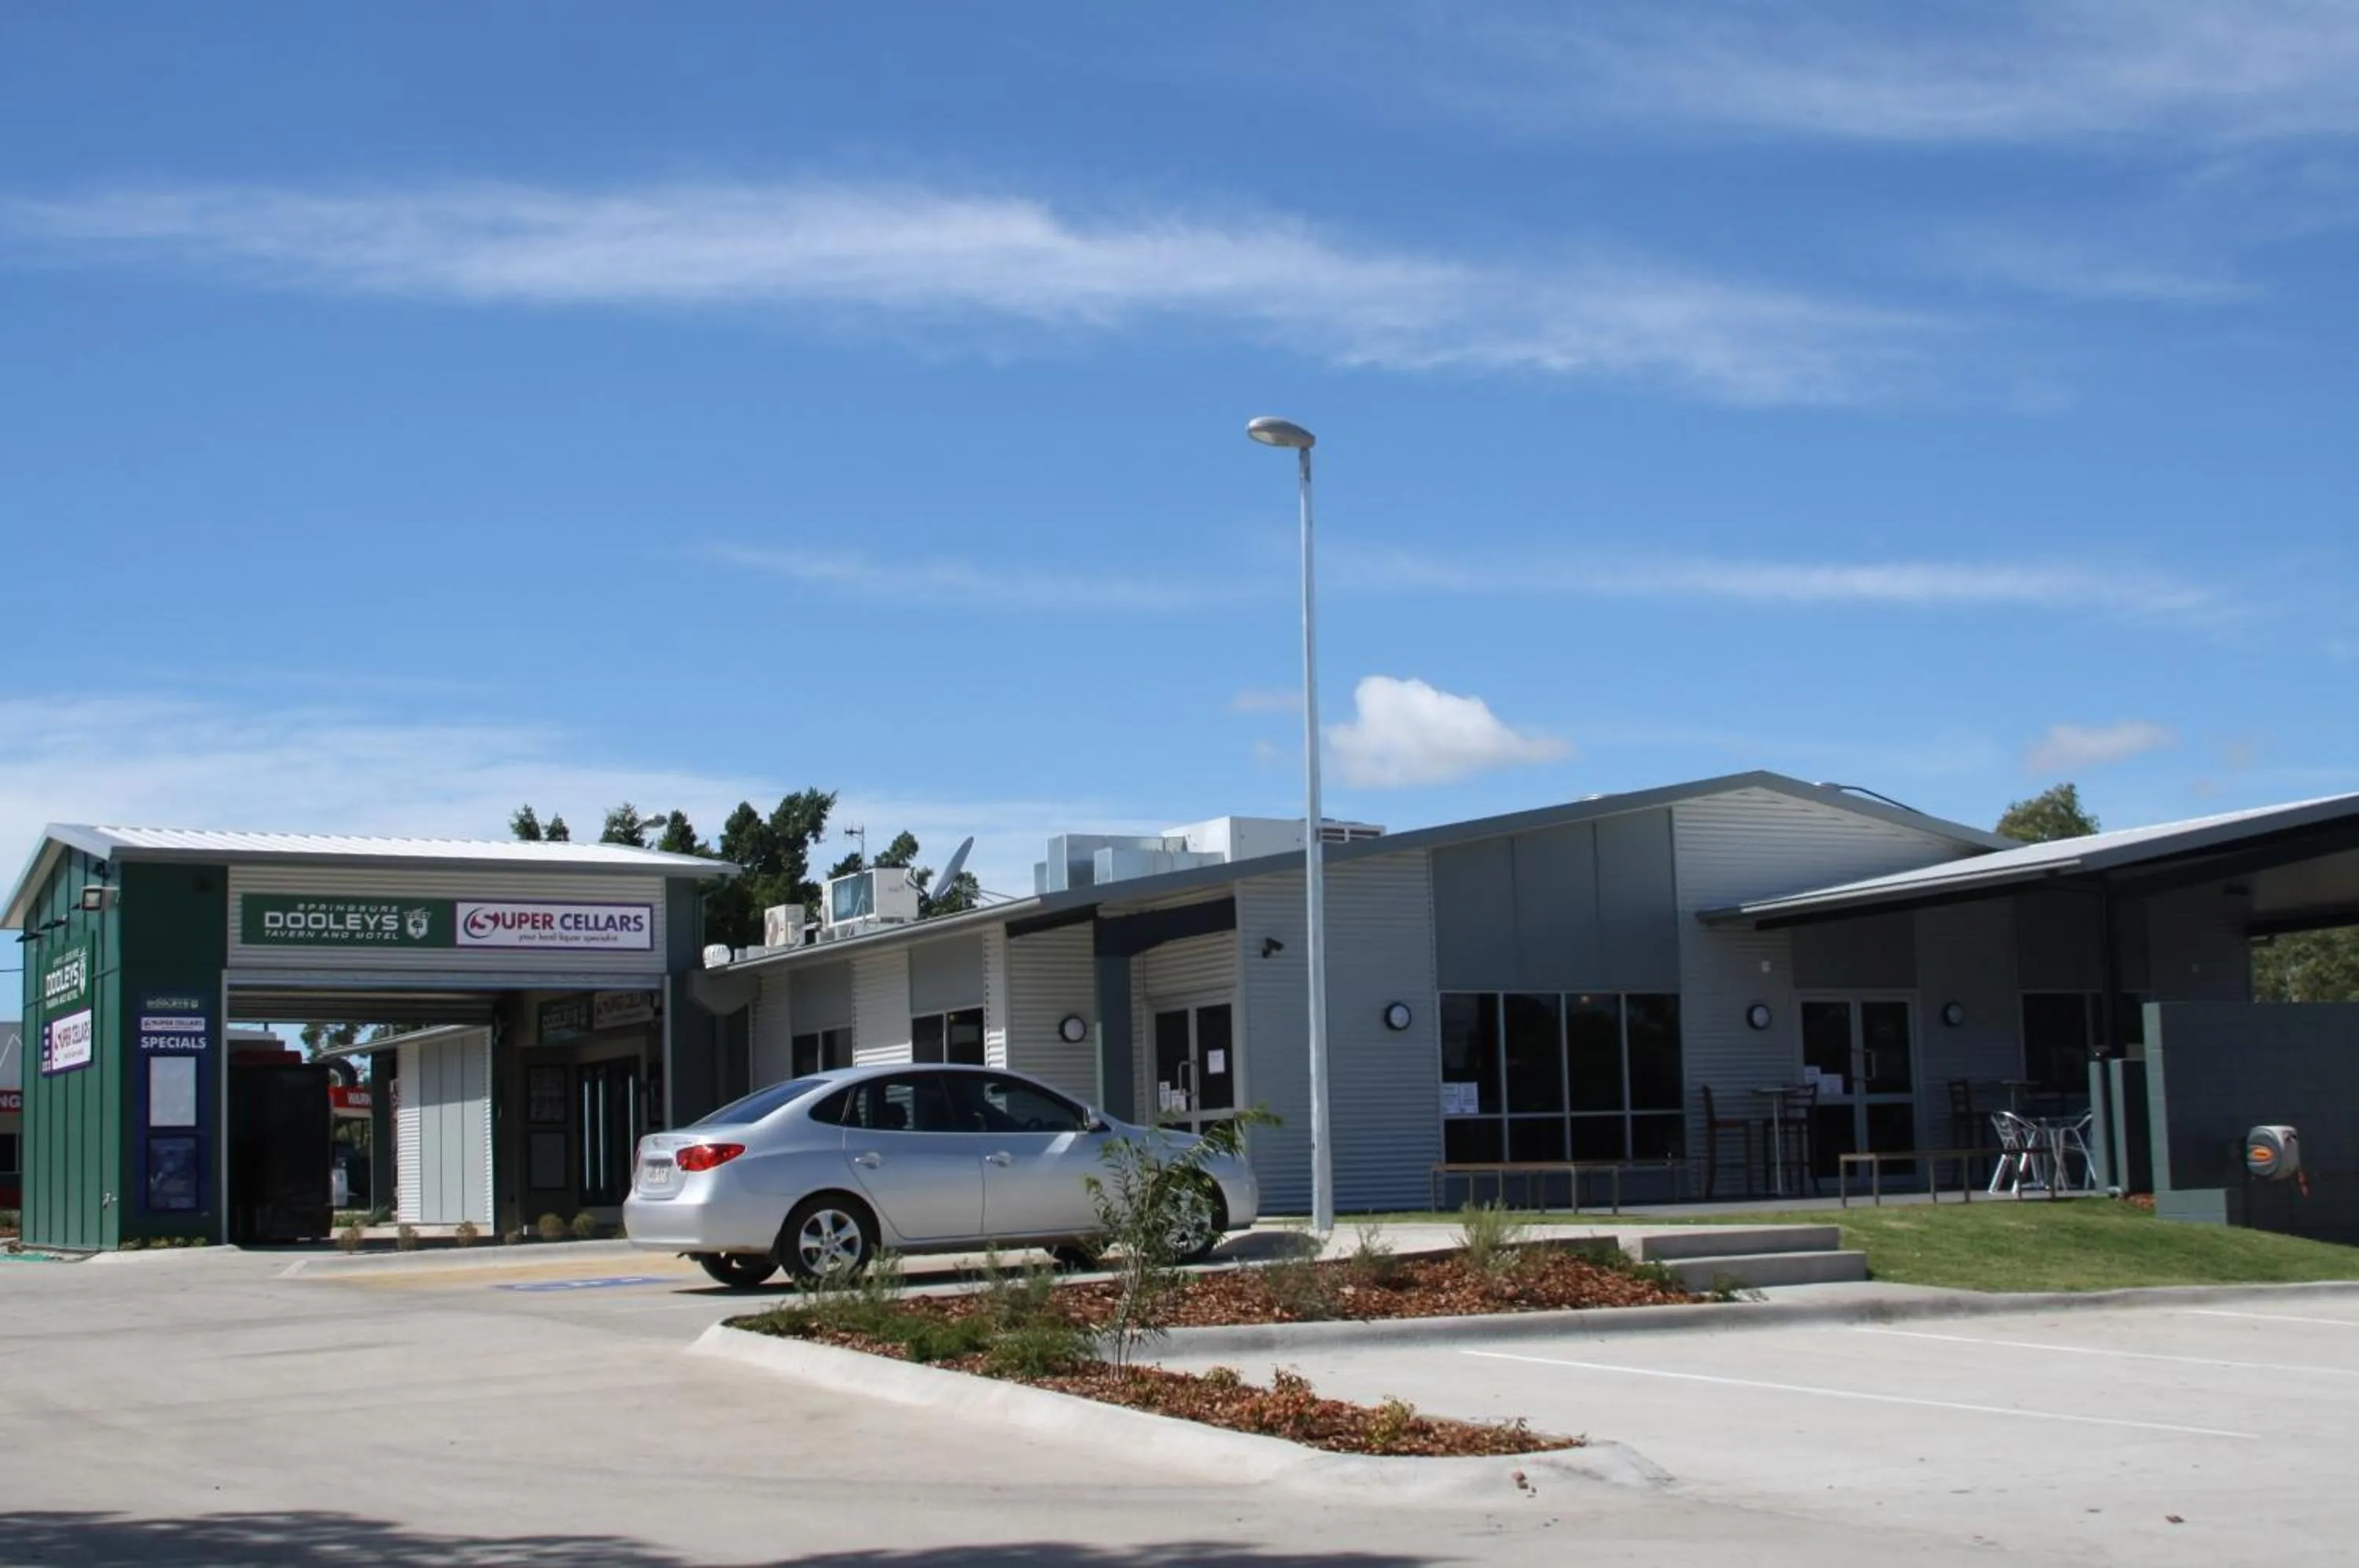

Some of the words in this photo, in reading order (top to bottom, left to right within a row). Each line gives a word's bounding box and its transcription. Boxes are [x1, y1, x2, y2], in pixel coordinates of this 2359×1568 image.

[296, 903, 399, 913] SPRINGSURE
[264, 911, 399, 931] DOOLEYS
[559, 913, 645, 933] CELLARS
[264, 929, 315, 939] TAVERN
[141, 1035, 207, 1049] SPECIALS
